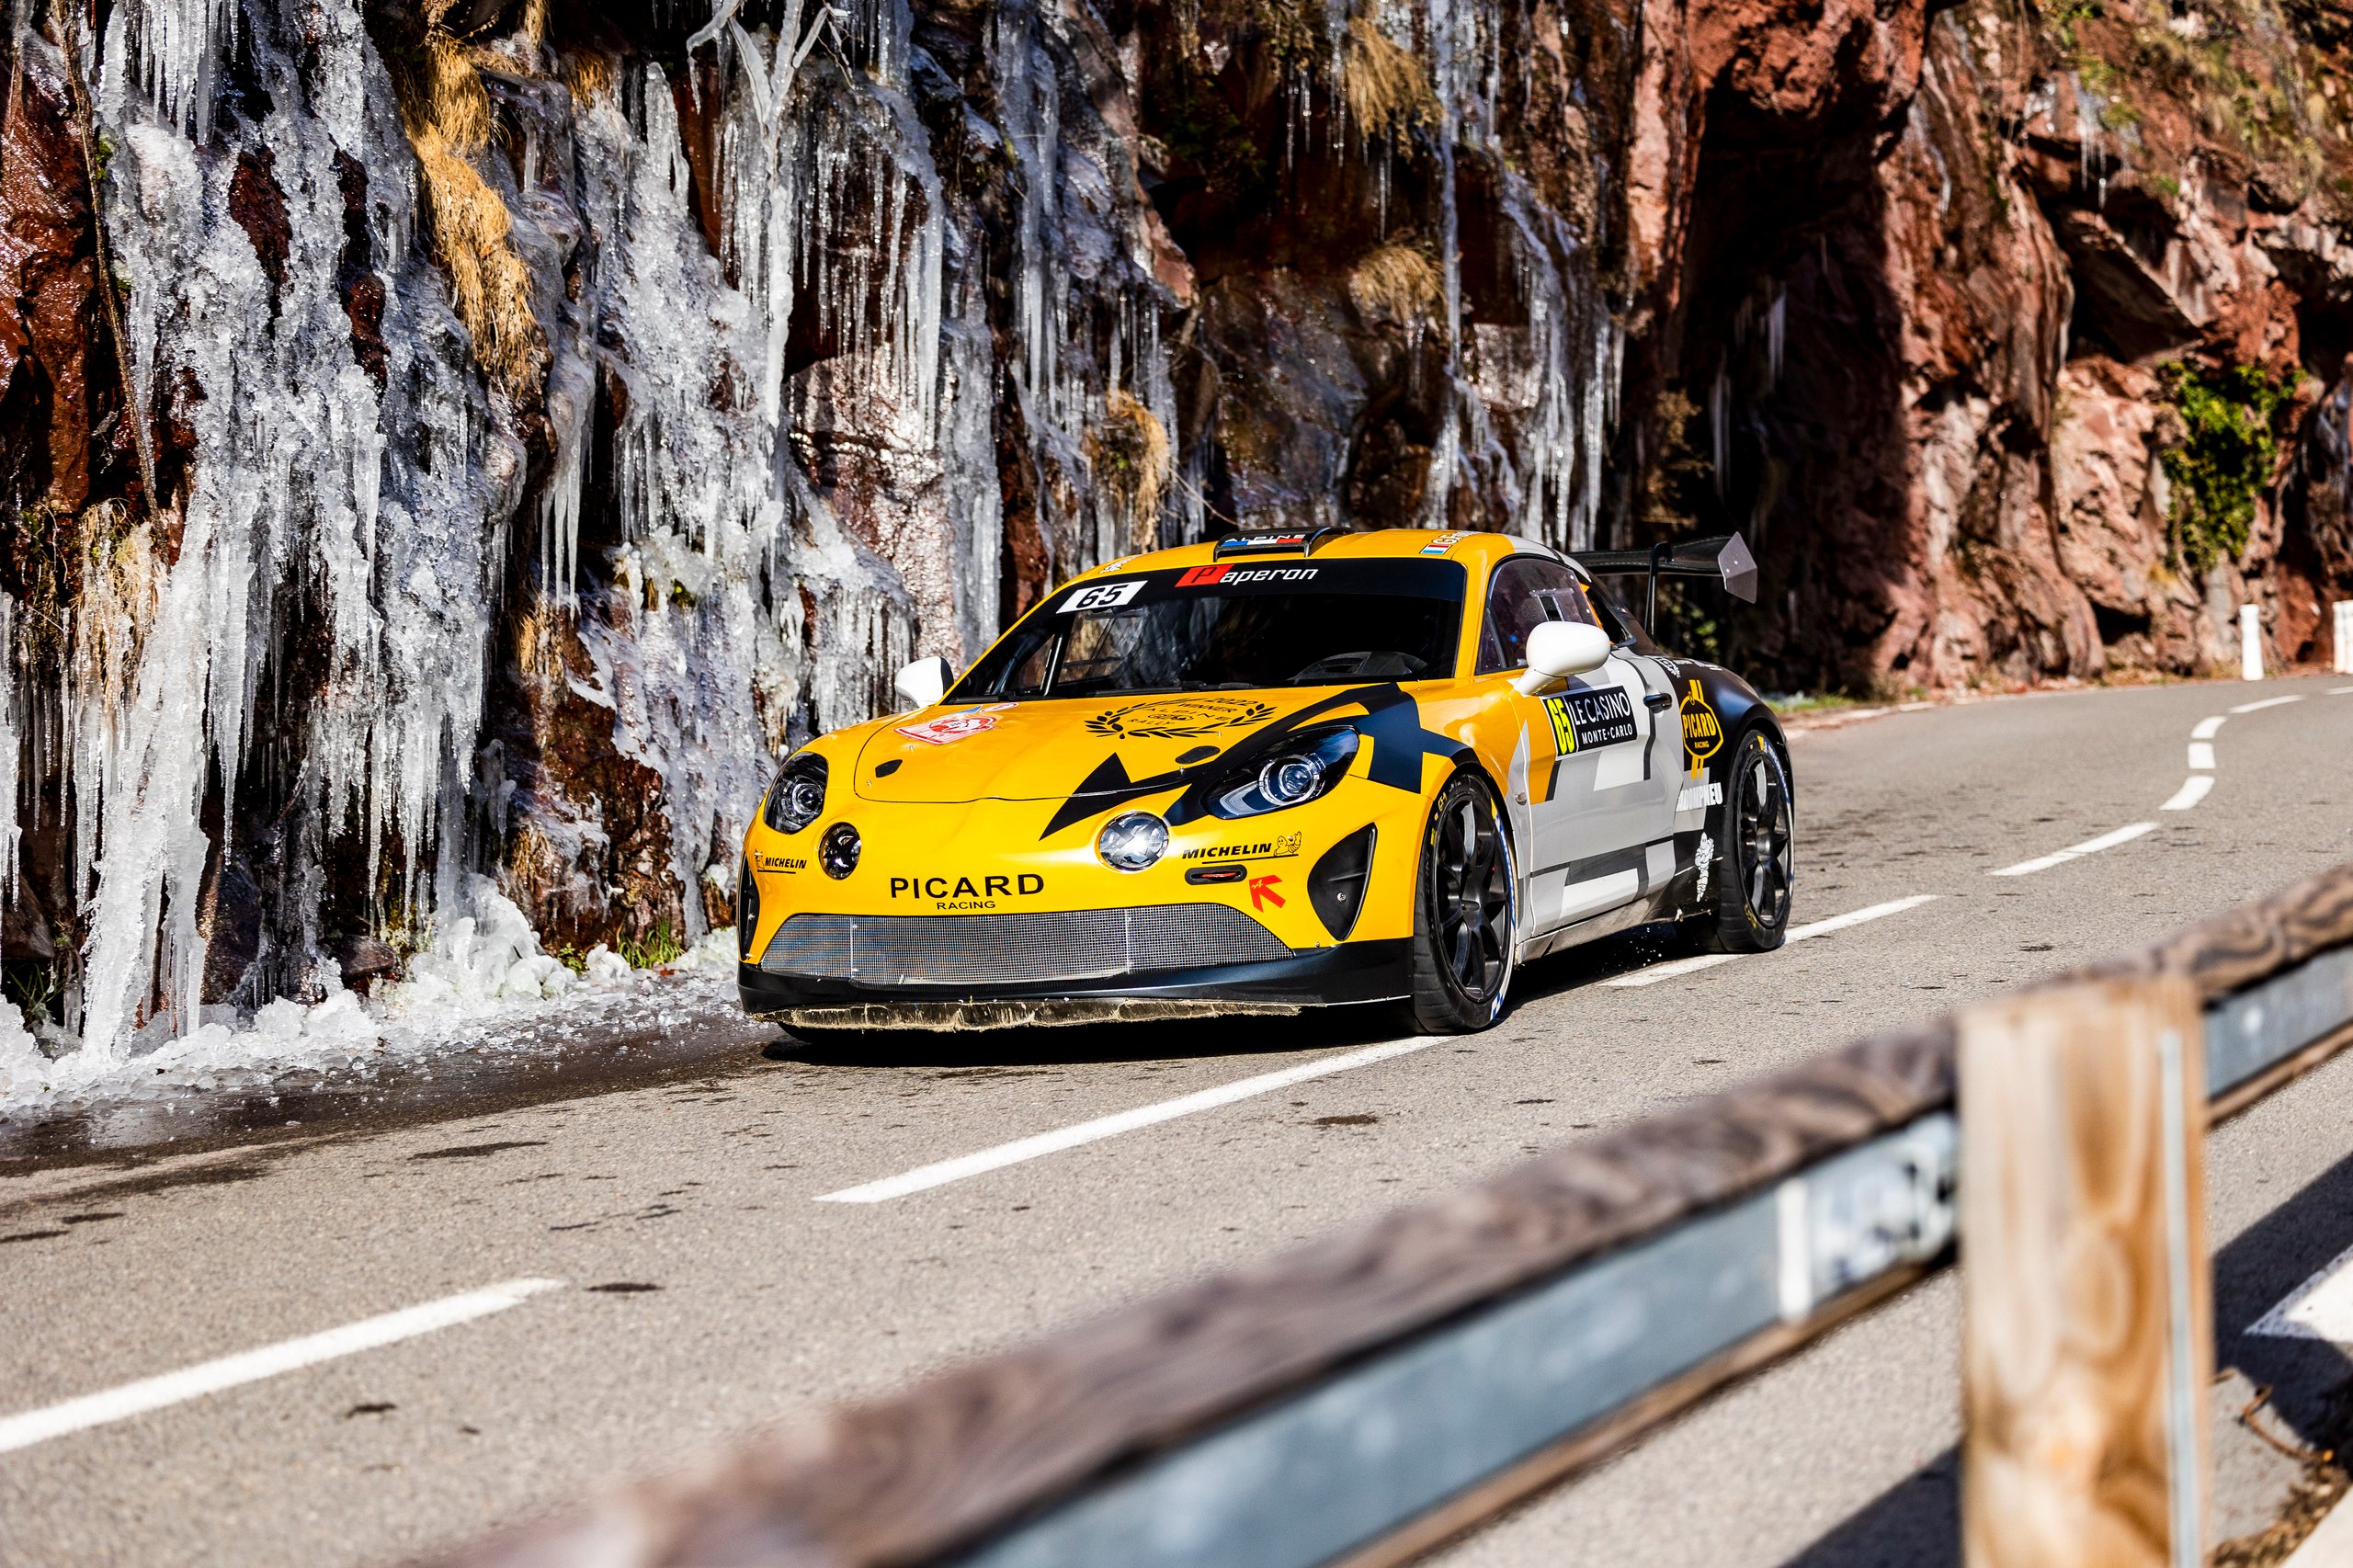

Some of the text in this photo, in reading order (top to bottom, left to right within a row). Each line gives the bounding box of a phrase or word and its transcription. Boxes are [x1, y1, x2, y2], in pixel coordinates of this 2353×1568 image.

[1194, 566, 1318, 585] Paperon
[1075, 585, 1128, 608] 65
[1178, 703, 1237, 712] WINNER
[1569, 692, 1631, 725] LE CASINO
[1547, 698, 1575, 755] 65
[1682, 712, 1716, 738] PICARD
[1182, 843, 1272, 859] MICHELIN
[765, 857, 807, 869] MICHELIN
[891, 874, 1044, 899] PICARD
[937, 901, 995, 910] RACING
